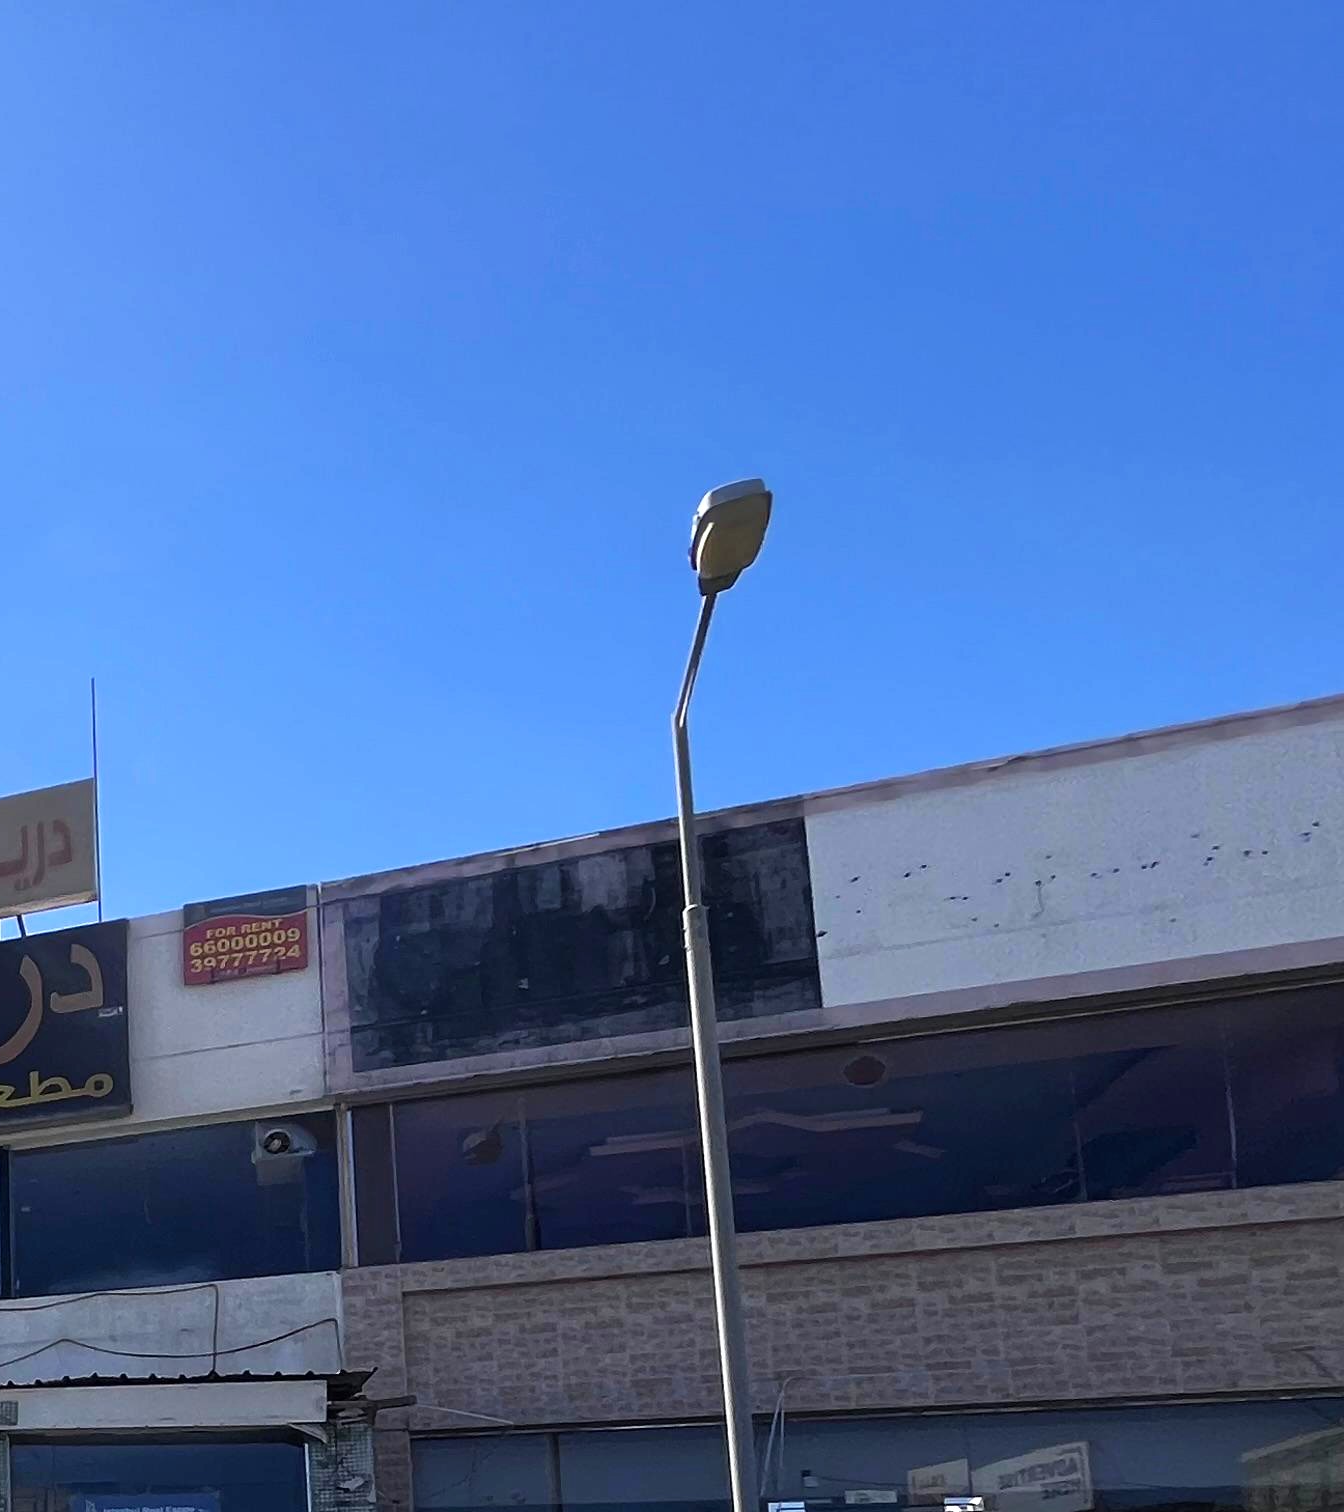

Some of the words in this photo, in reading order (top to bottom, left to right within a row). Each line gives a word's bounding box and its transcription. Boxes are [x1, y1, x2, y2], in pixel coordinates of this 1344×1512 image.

[189, 928, 301, 957] 66000009
[206, 926, 236, 939] FOR
[240, 919, 283, 934] RENT
[190, 945, 300, 973] 39777724
